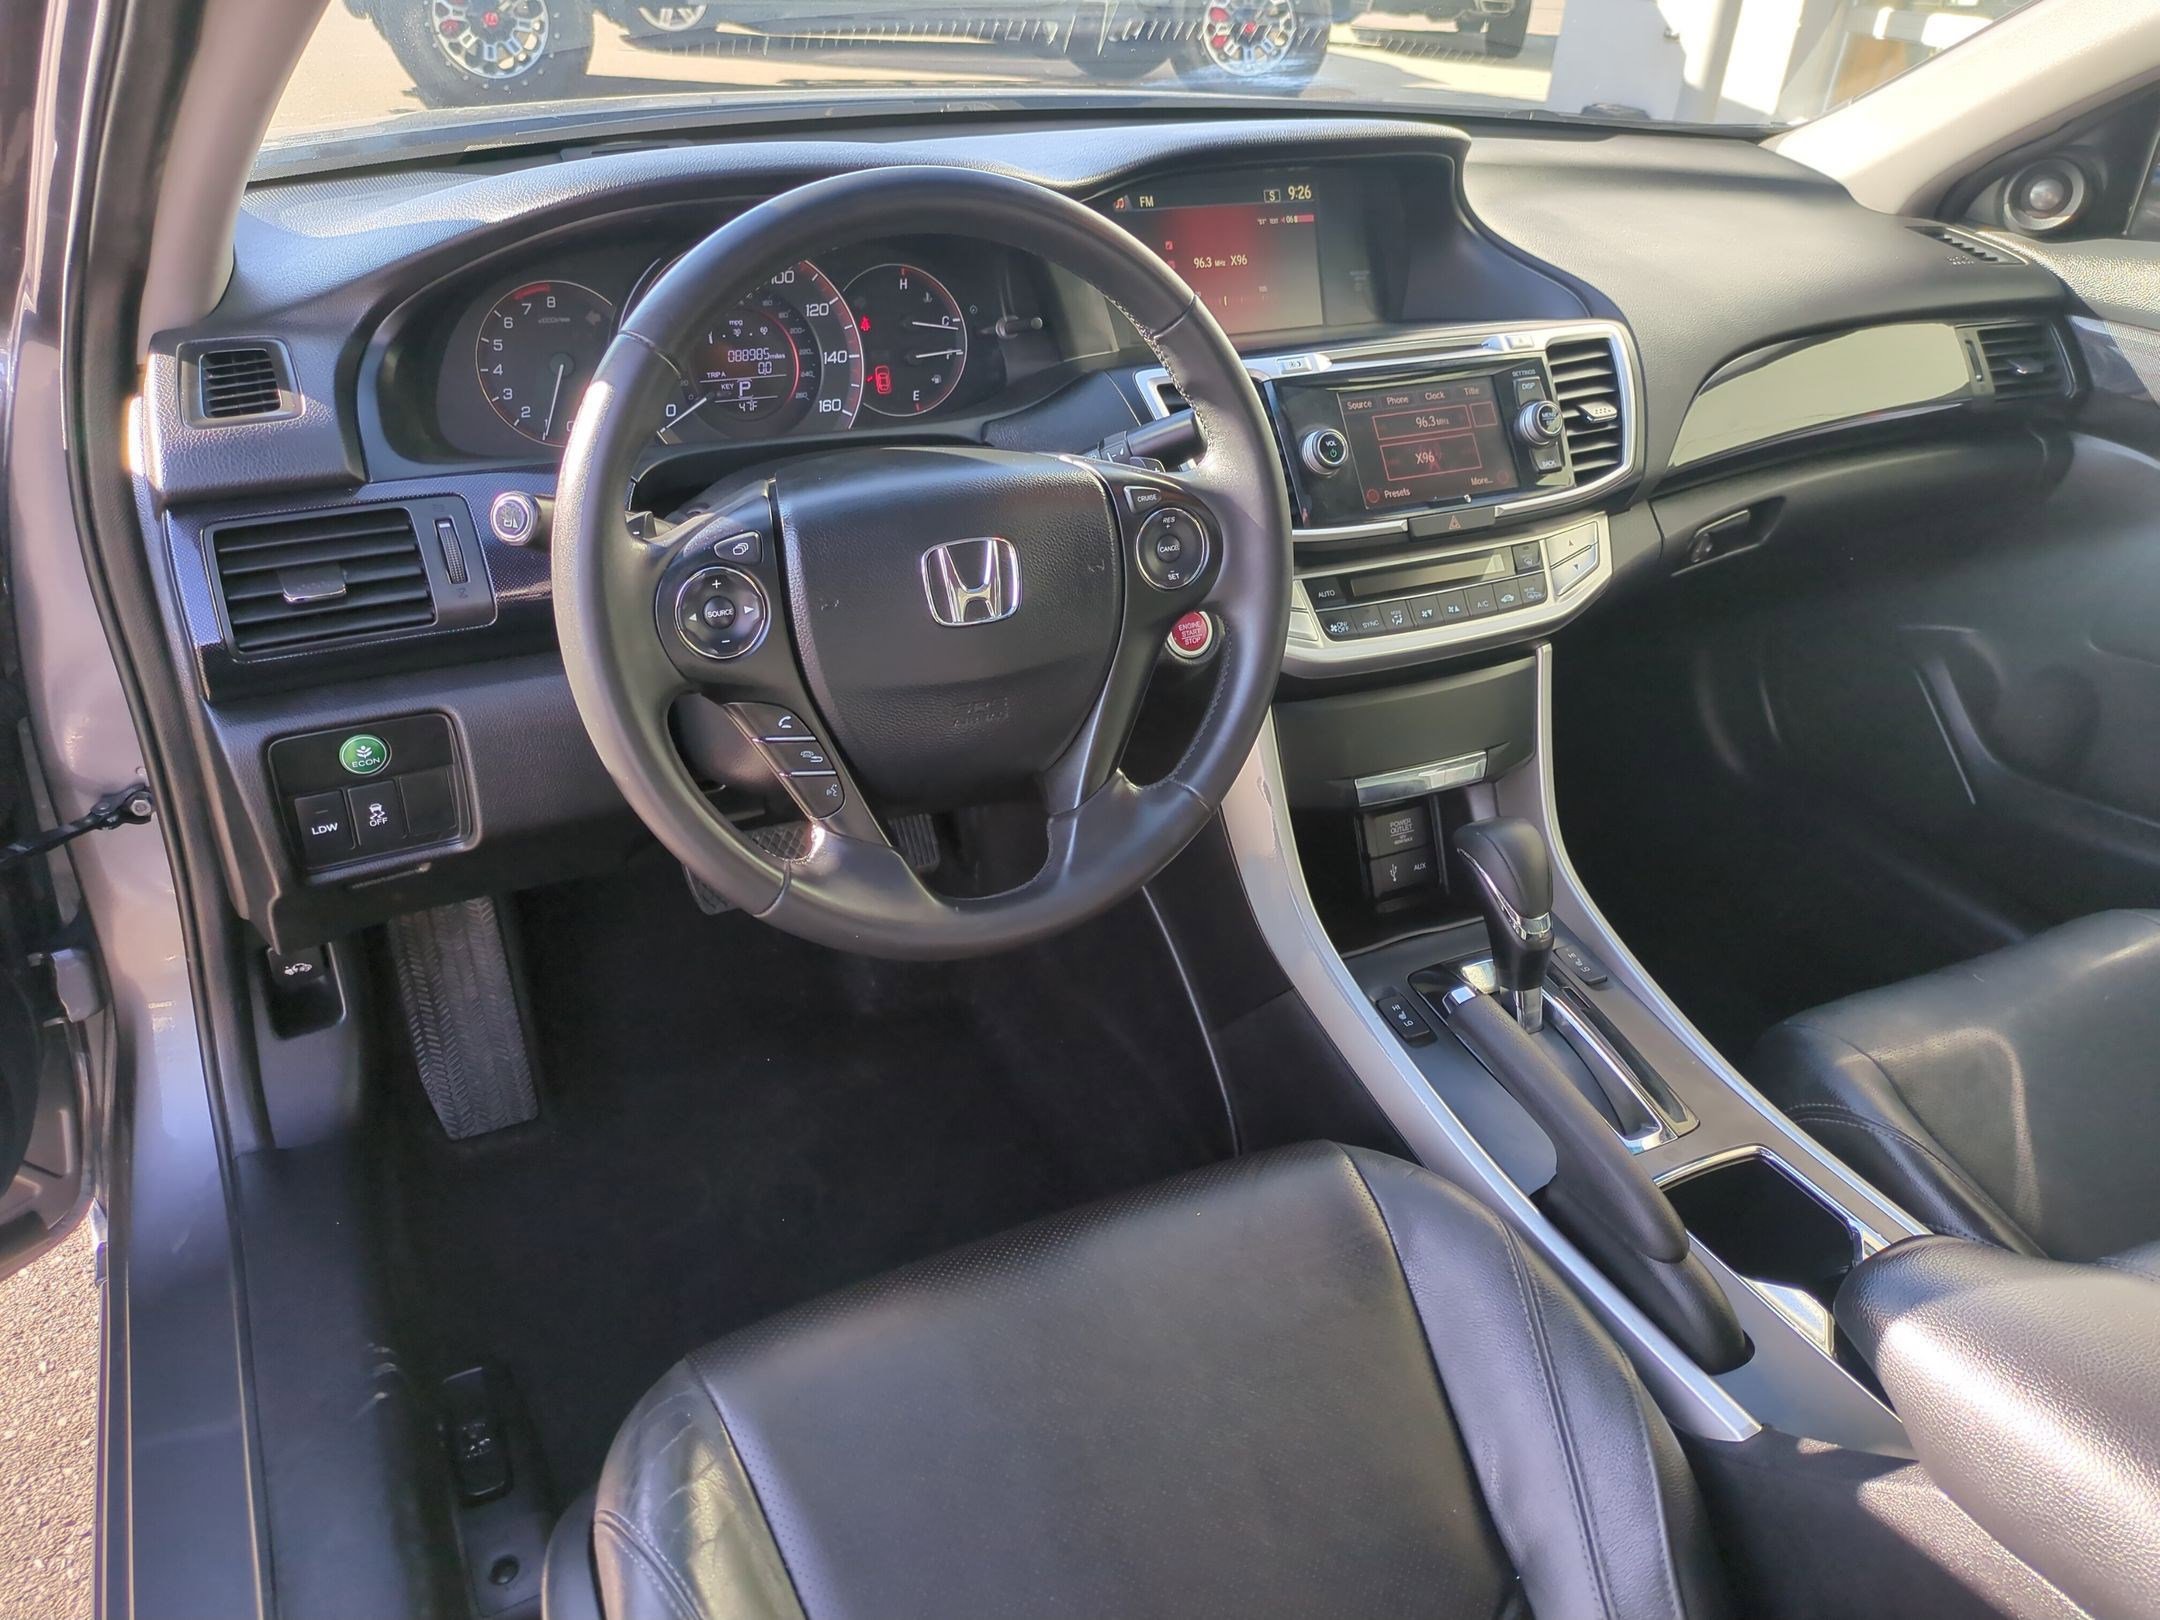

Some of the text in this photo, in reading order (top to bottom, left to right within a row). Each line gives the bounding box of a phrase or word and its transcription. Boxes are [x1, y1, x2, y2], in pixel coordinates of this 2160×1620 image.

[1288, 185, 1312, 200] 9:26
[1139, 196, 1154, 208] FM
[1193, 257, 1212, 269] 96.3
[1230, 255, 1248, 266] X96
[900, 278, 907, 290] H
[547, 297, 556, 308] 8
[521, 303, 532, 315] 7
[806, 303, 829, 317] 120
[504, 317, 513, 329] 6
[941, 316, 950, 327] C
[493, 339, 503, 351] 5
[823, 350, 847, 364] 140
[492, 364, 503, 376] 4
[739, 381, 752, 397] P
[1463, 387, 1480, 396] Title
[1521, 382, 1536, 390] DISP
[503, 388, 513, 400] 3
[913, 390, 920, 401] E
[1424, 391, 1446, 401] Clock
[819, 399, 842, 413] 160
[1347, 401, 1373, 411] Source
[1386, 396, 1409, 405] Phone
[521, 406, 531, 418] 2
[666, 404, 676, 417] 0
[1415, 415, 1436, 429] 96.3
[1415, 451, 1435, 465] X96
[1137, 493, 1157, 503] CRUISE
[1384, 488, 1411, 500] Presets
[1162, 516, 1176, 524] RES
[1159, 545, 1180, 553] CANCEL
[1167, 573, 1180, 581] SET
[1317, 589, 1336, 599] AUTO
[707, 607, 734, 619] SOURCE
[1178, 621, 1201, 632] ENGINE
[1362, 619, 1380, 629] SYNC
[1181, 628, 1201, 638] START
[1184, 636, 1201, 646] STOP
[351, 757, 381, 769] ECON
[369, 816, 388, 827] OFF
[311, 822, 339, 836] LDW
[1413, 863, 1426, 871] AUX
